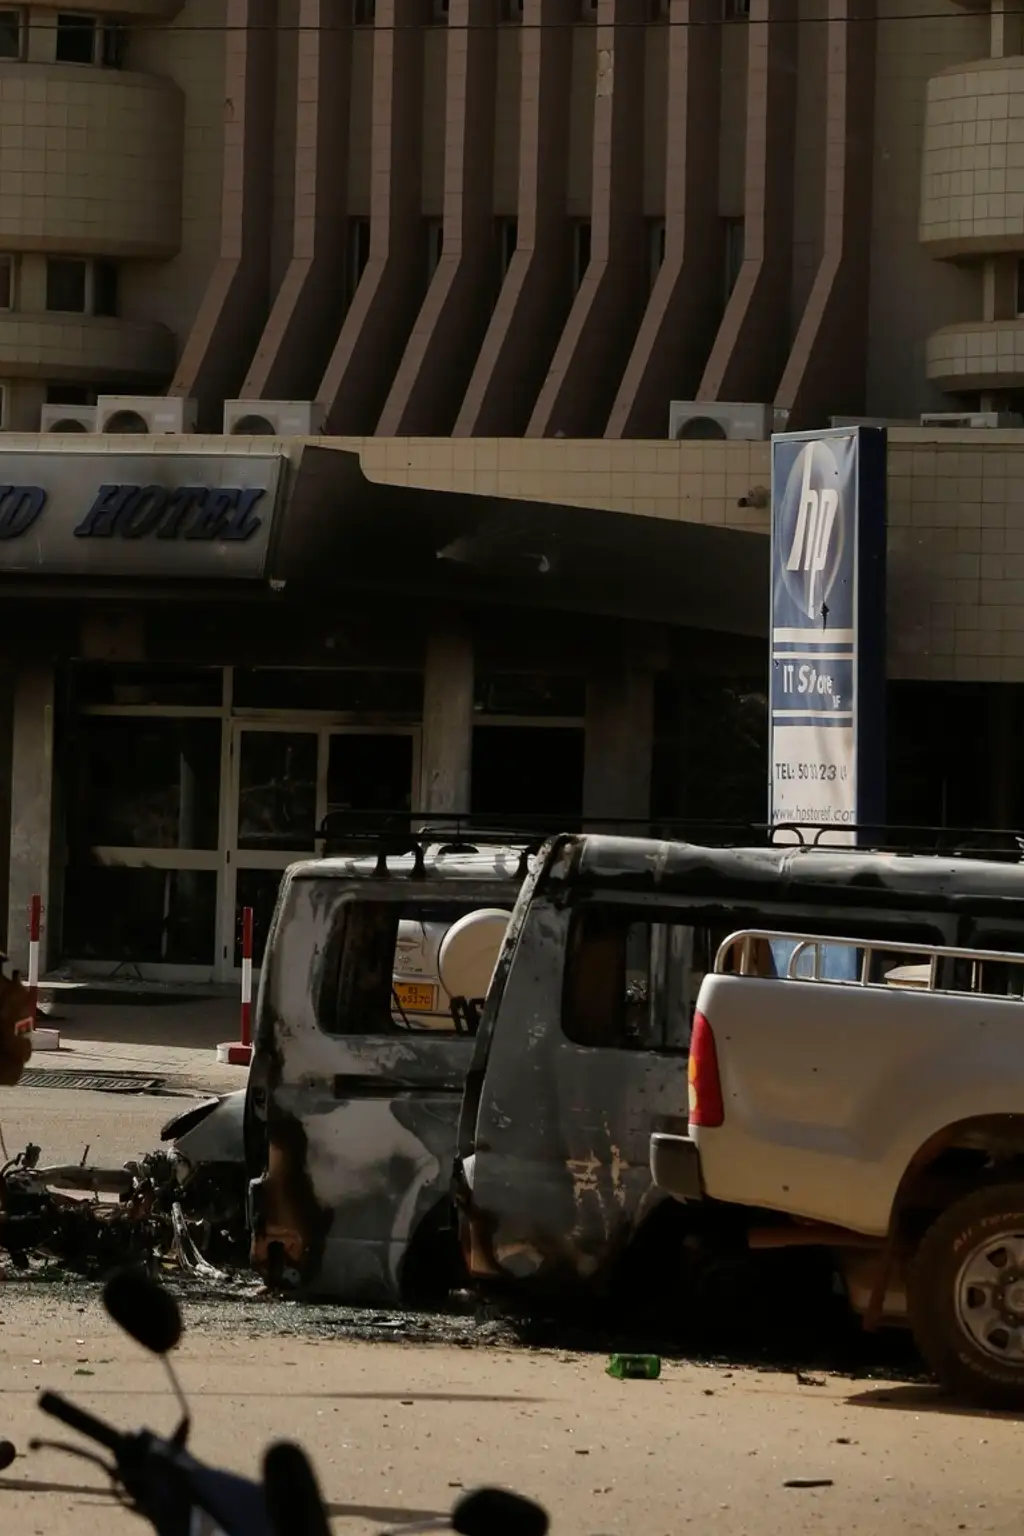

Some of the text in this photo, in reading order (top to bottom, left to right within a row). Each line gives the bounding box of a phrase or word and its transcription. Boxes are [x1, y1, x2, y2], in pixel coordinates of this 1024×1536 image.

[73, 484, 267, 541] HOTEL
[786, 441, 839, 620] hp
[783, 664, 794, 693] IT
[775, 762, 795, 780] TEL:
